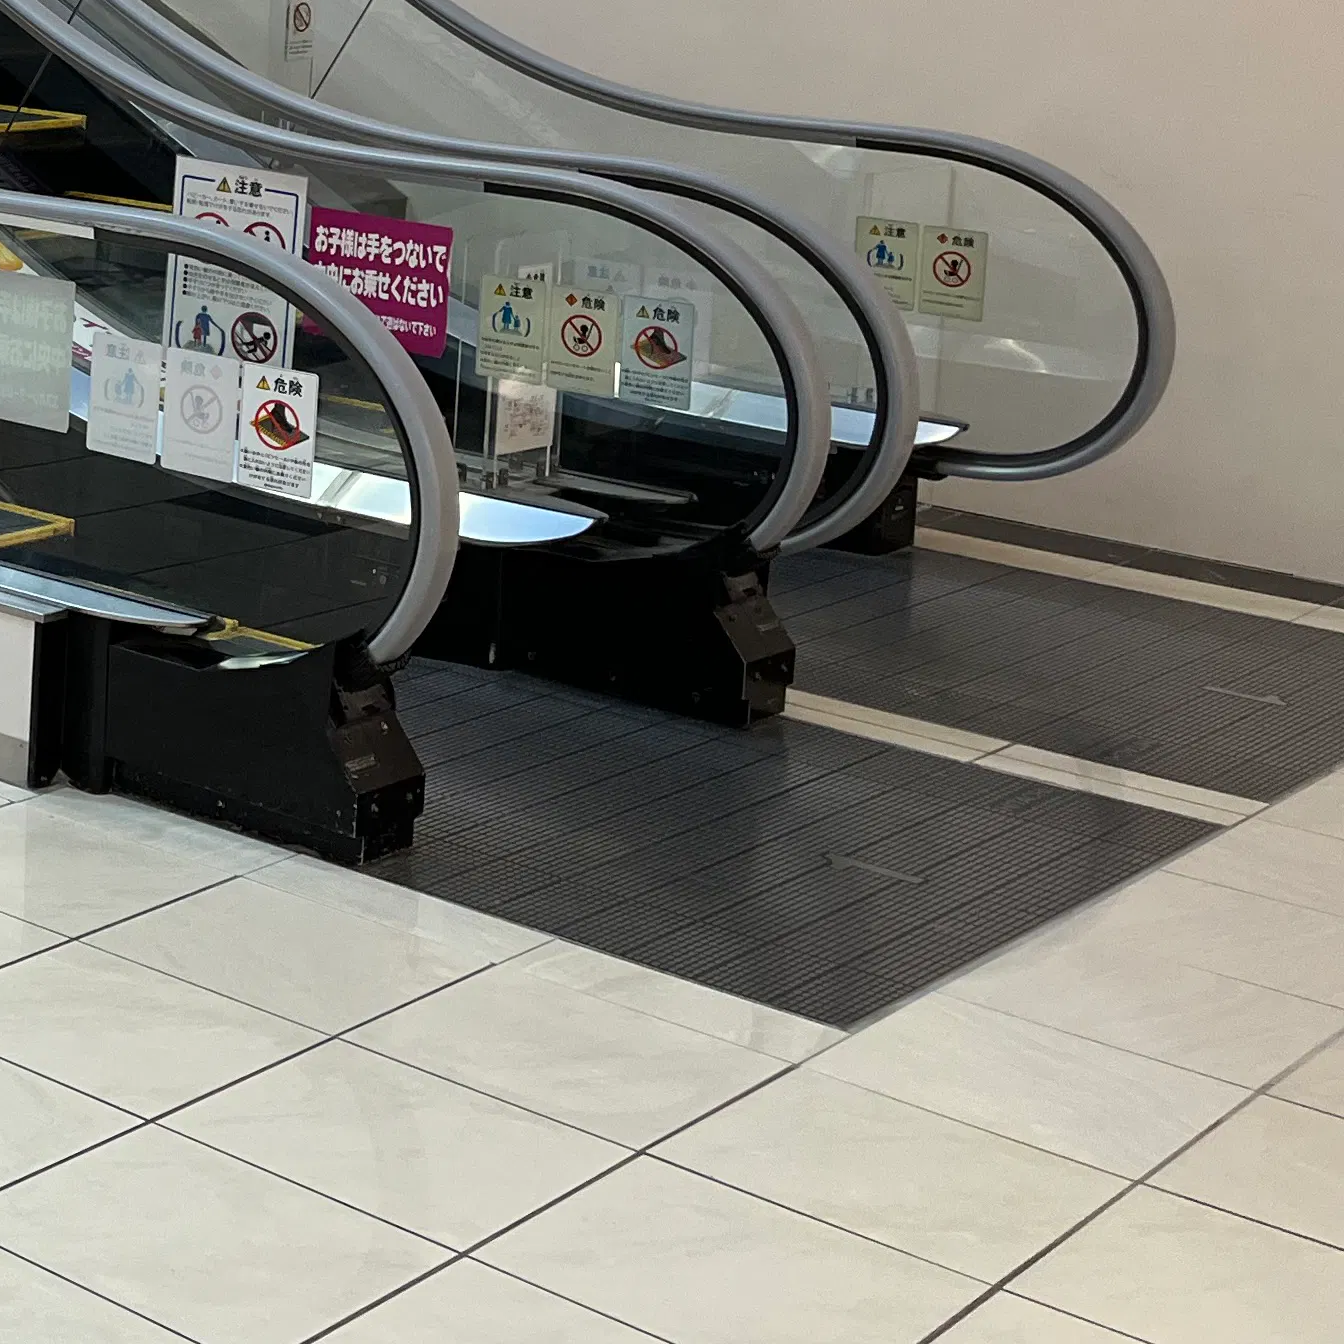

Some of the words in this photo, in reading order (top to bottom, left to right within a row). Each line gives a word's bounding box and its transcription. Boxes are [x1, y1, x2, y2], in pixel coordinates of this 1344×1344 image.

[234, 177, 263, 198] 注意
[884, 225, 906, 239] 注意
[314, 224, 447, 273] お子様は手をつないで
[509, 283, 534, 301] 注意
[580, 294, 606, 312] 危険
[652, 305, 681, 325] 危険
[274, 376, 304, 398] 危険
